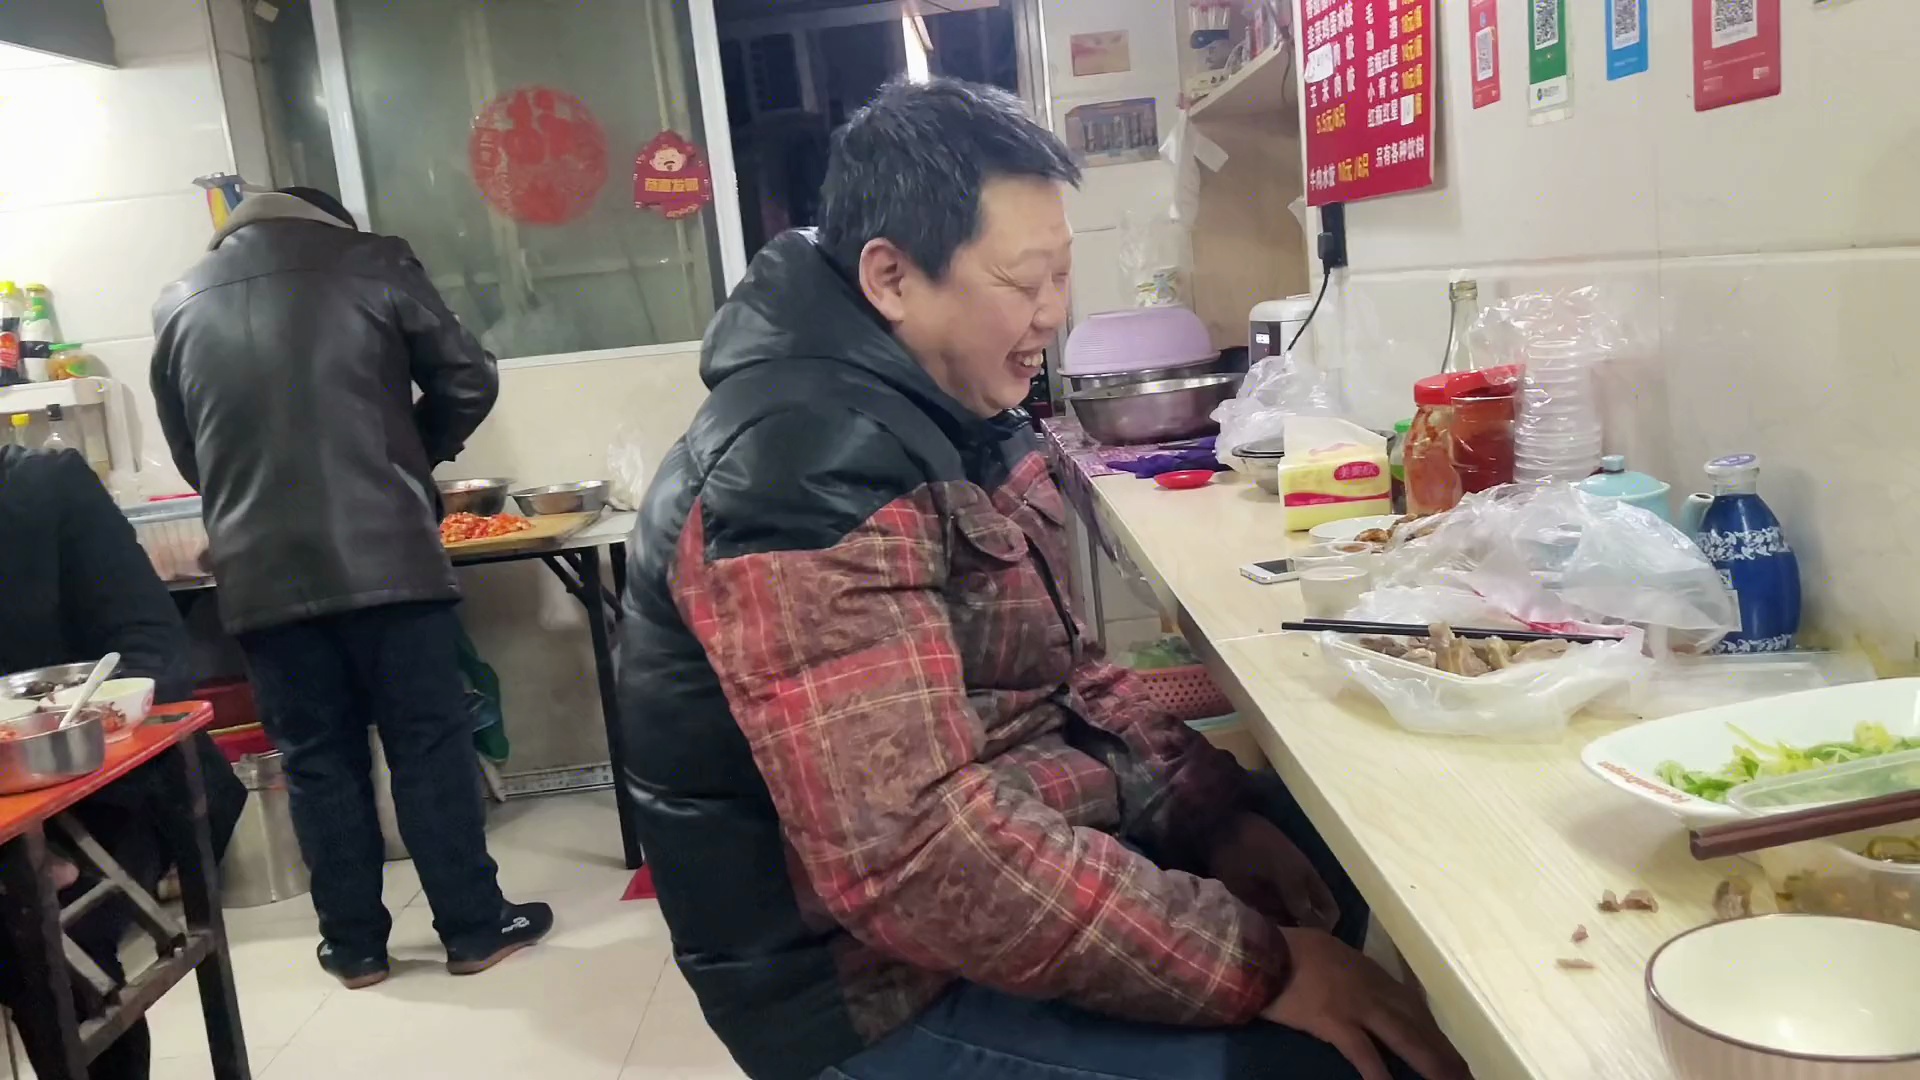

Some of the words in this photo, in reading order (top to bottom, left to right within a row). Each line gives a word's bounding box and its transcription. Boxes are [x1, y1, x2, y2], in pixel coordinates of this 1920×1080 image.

[1375, 134, 1424, 168] 另有各种饮料
[1310, 163, 1335, 191] 牛肉水饺
